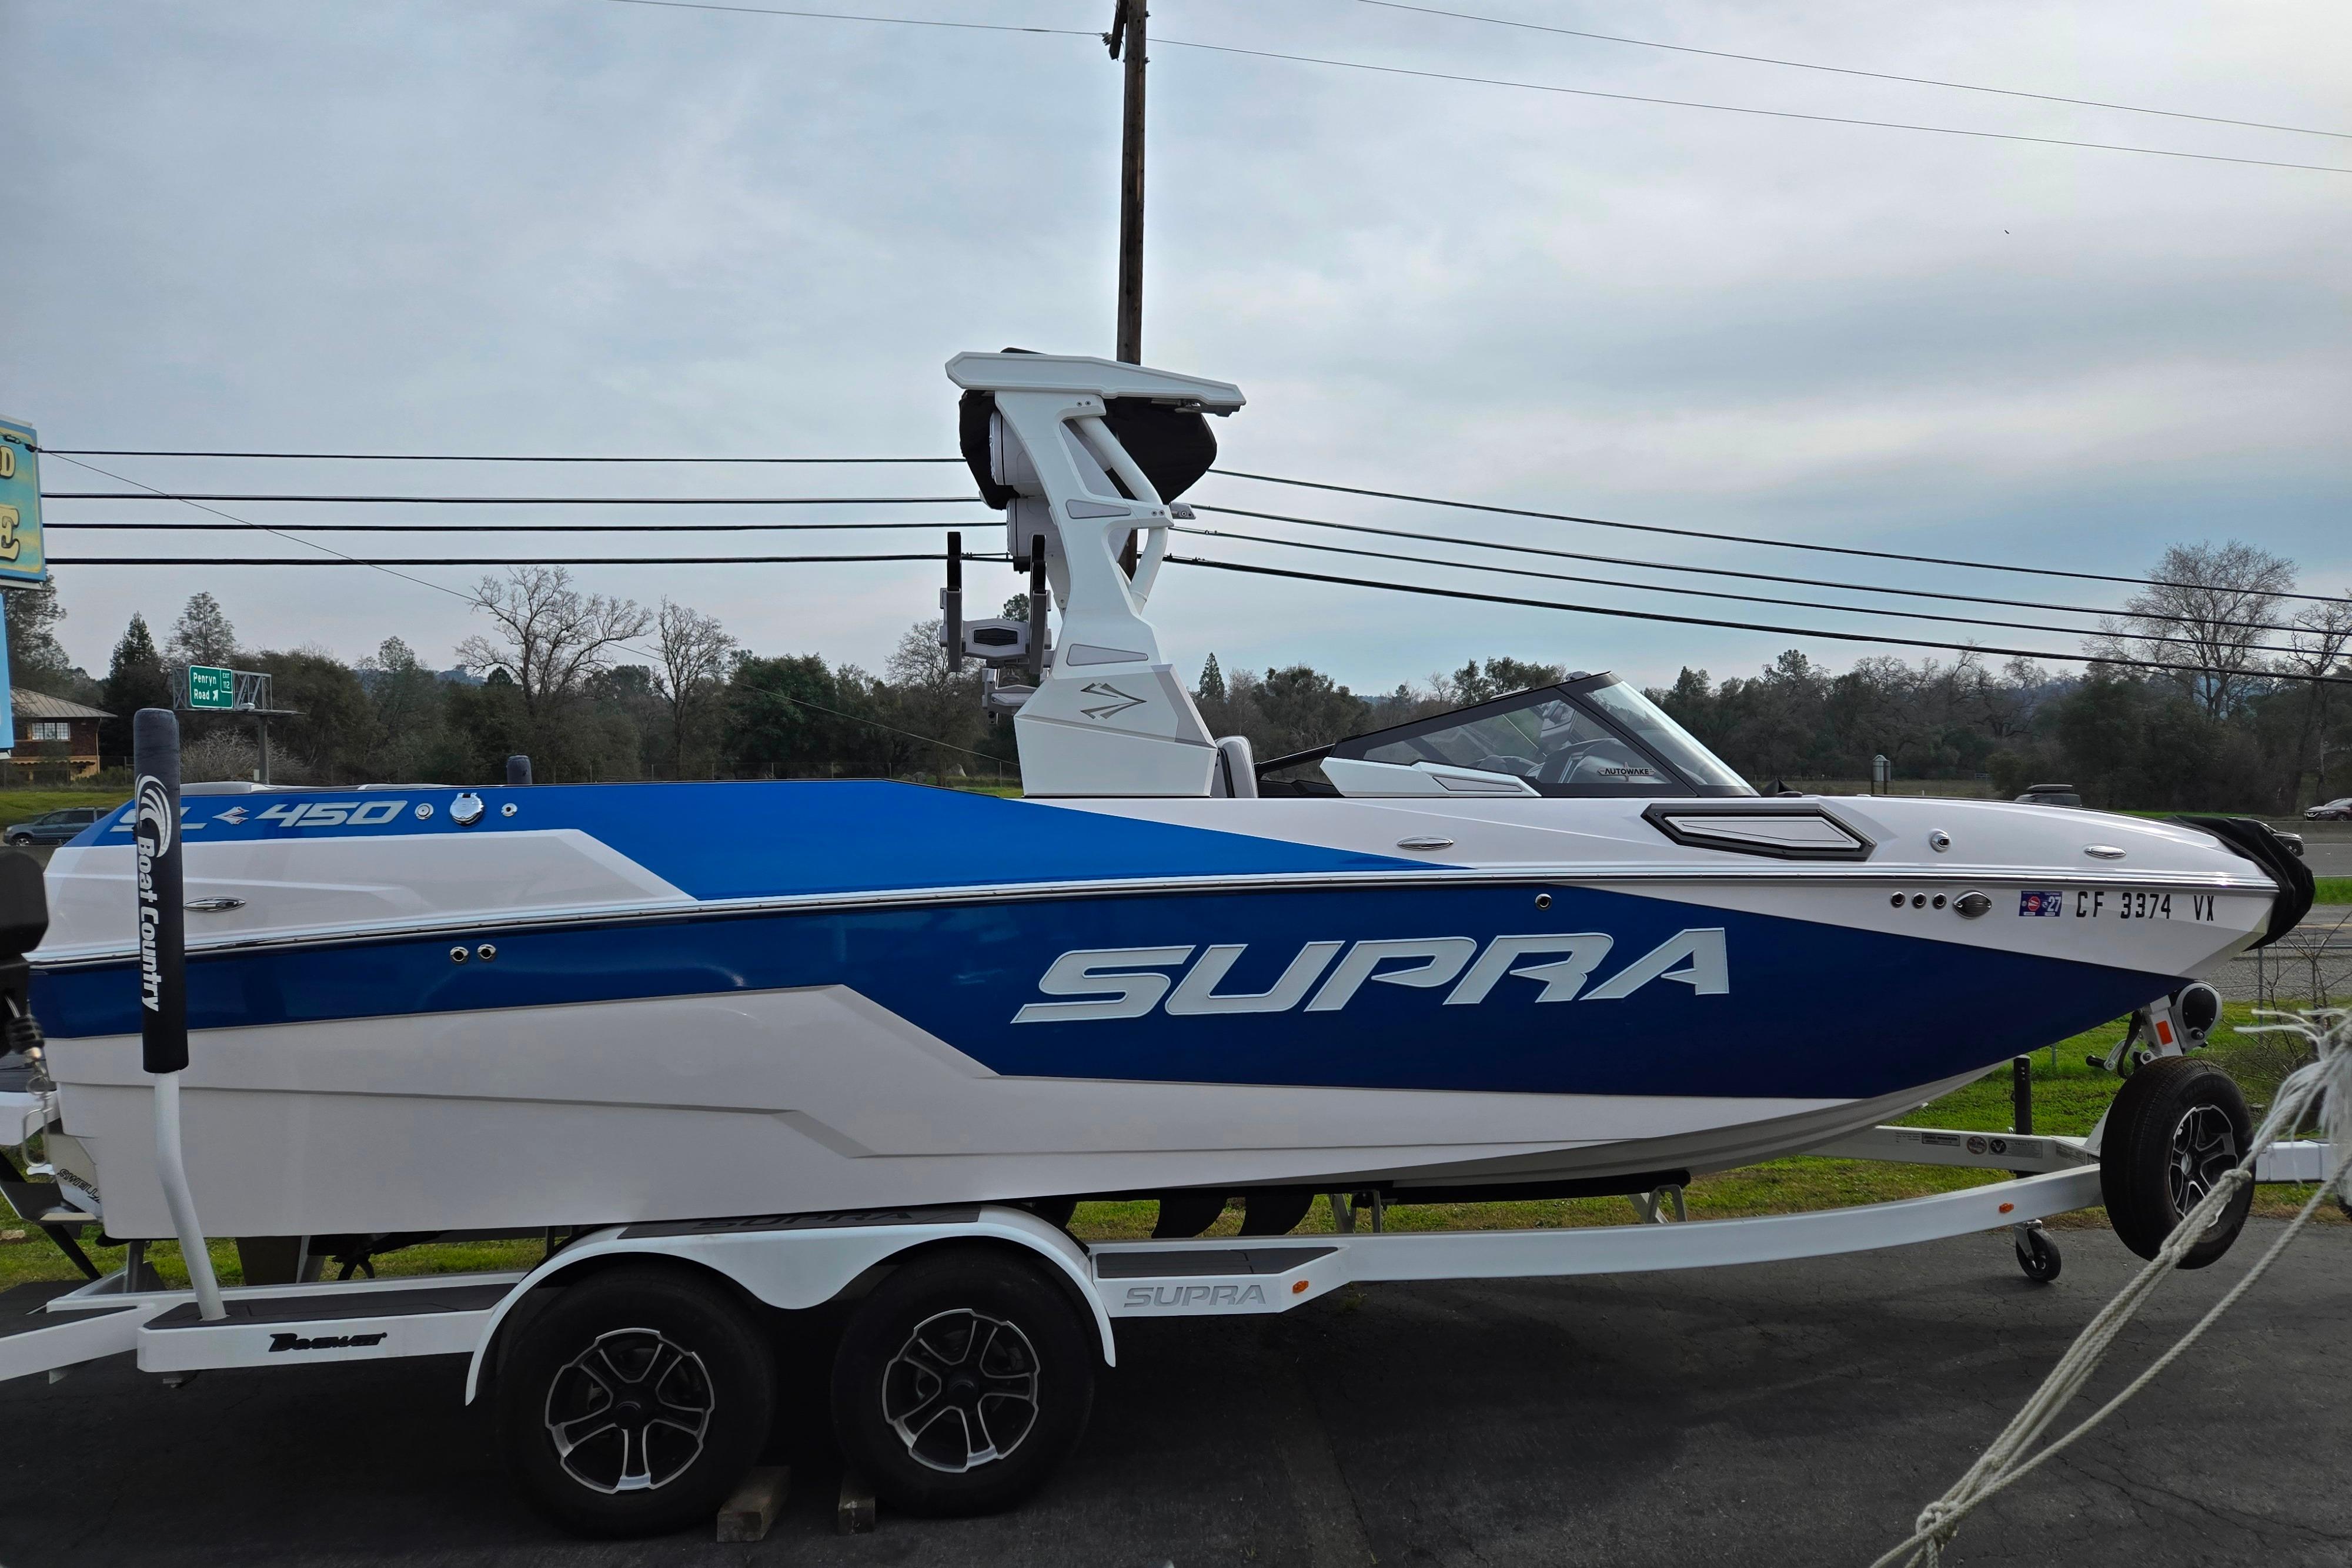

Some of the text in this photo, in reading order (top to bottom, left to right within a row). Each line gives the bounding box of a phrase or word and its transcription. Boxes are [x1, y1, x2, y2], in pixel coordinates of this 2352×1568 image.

[193, 672, 217, 687] Penryn
[193, 688, 210, 700] Road
[255, 800, 408, 828] 450
[2047, 895, 2062, 912] 27
[2076, 891, 2214, 921] CF 3374 VX
[137, 836, 162, 1012] Boat Country
[1010, 927, 1730, 1024] SUPRA
[57, 1168, 98, 1197] SWELL
[692, 1211, 913, 1229] SUPRA
[1123, 1284, 1267, 1308] SUPRA
